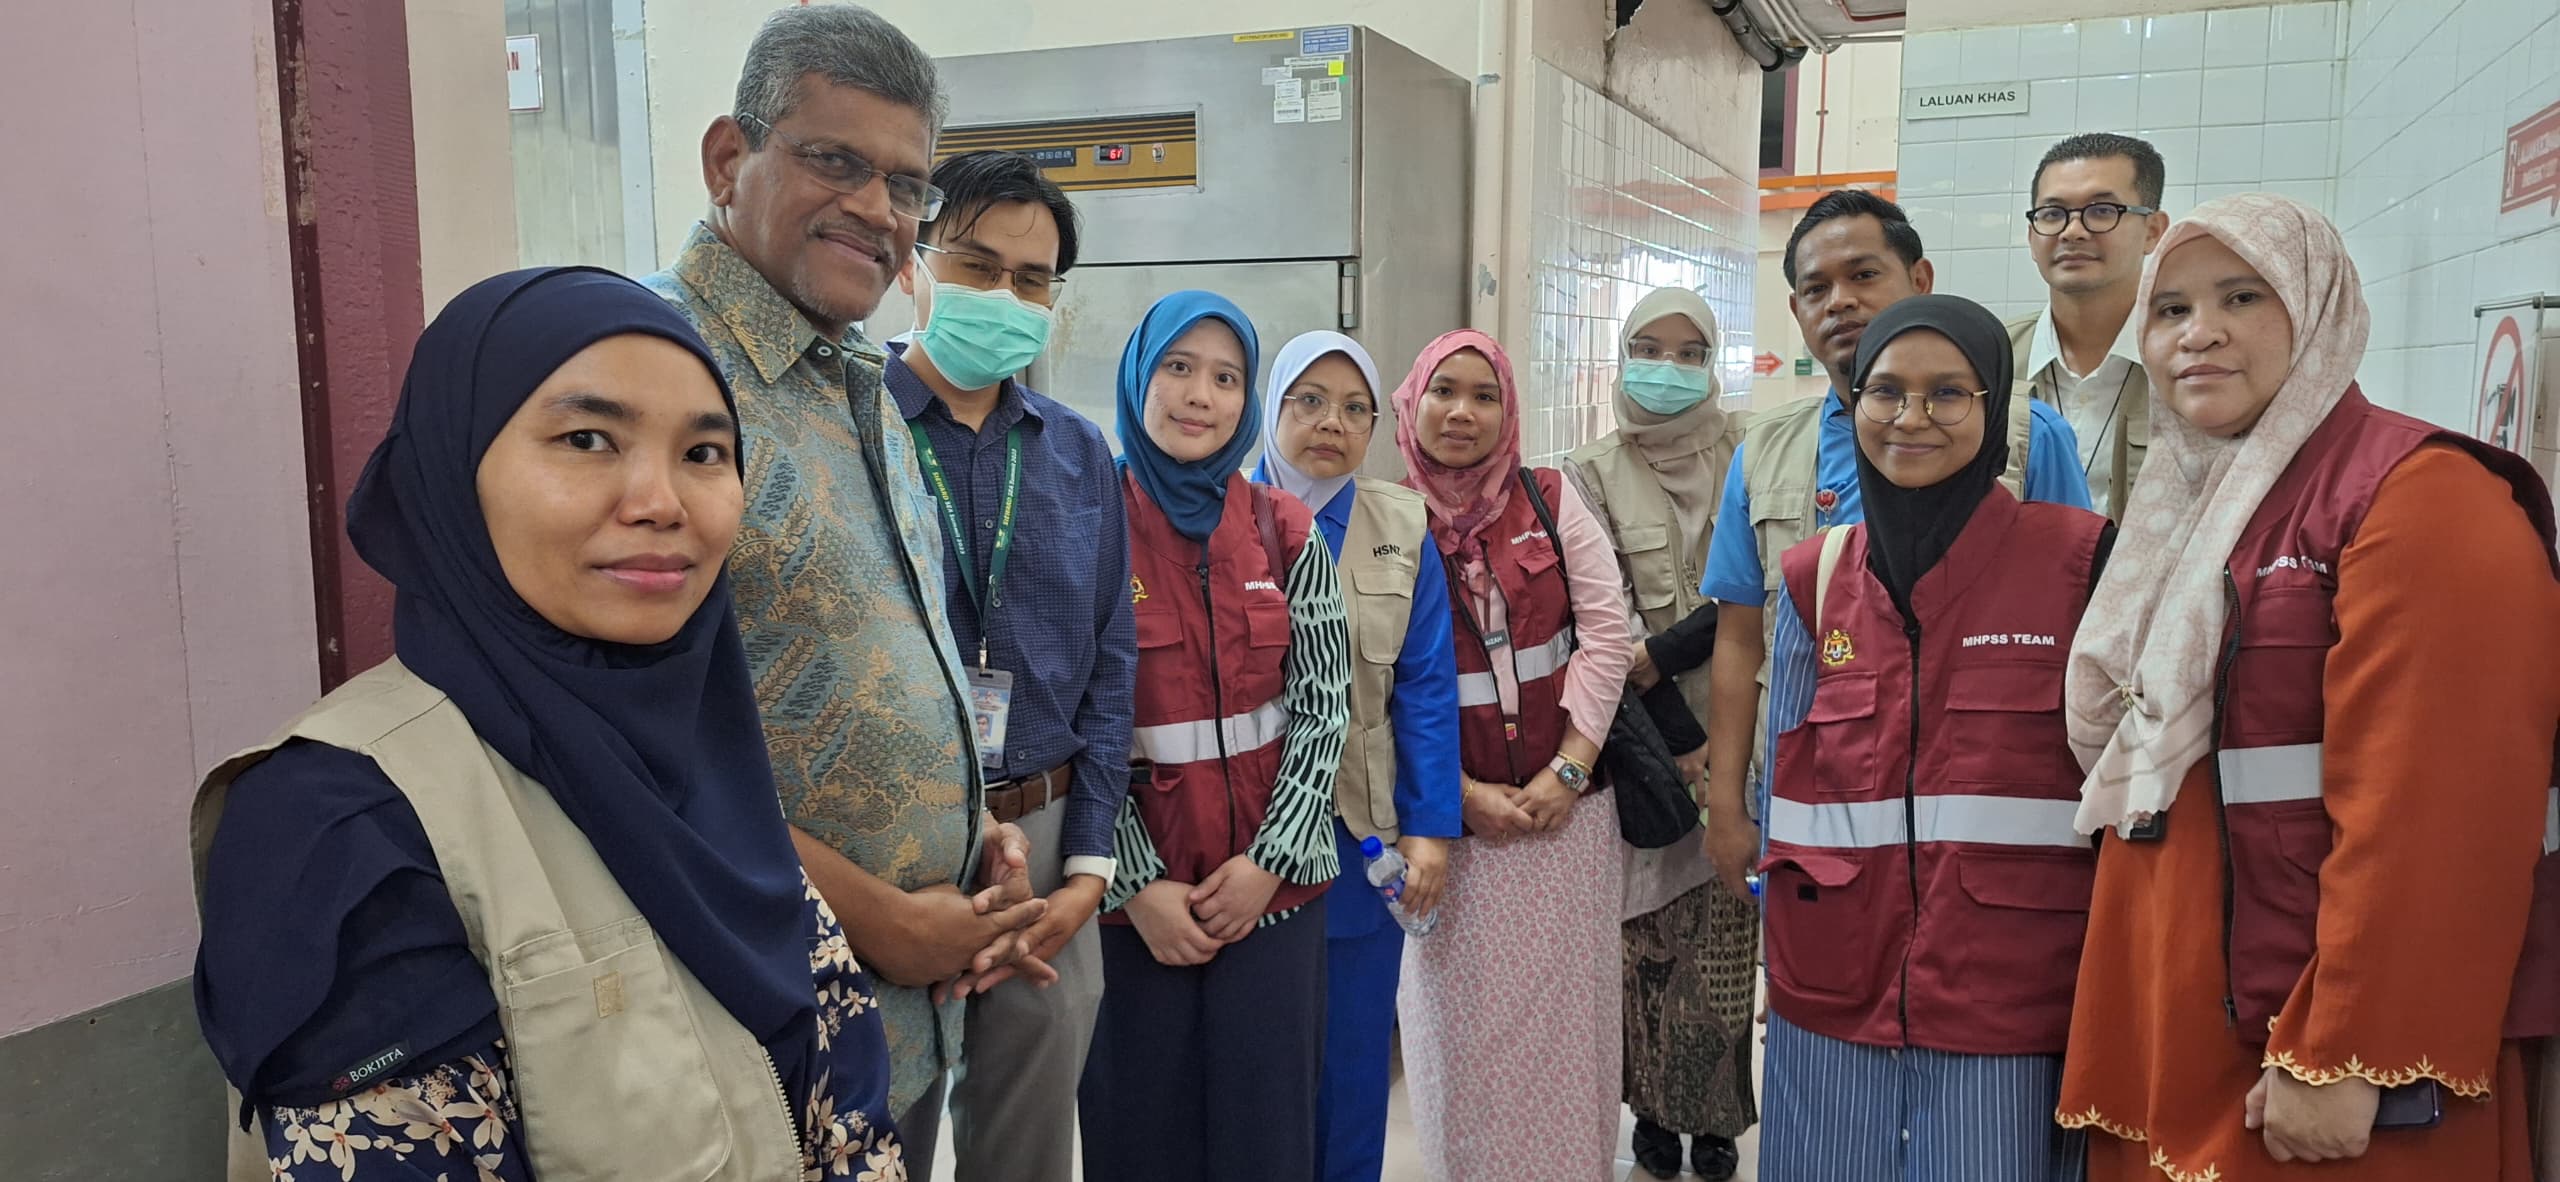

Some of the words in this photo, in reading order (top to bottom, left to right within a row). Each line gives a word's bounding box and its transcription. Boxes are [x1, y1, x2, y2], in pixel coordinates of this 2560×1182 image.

[1920, 93, 1974, 107] LALUAN
[1978, 91, 2016, 103] KHAS
[1962, 634, 2009, 647] MHPSS
[2012, 633, 2055, 646] TEAM
[349, 1048, 404, 1082] BOKITTA
